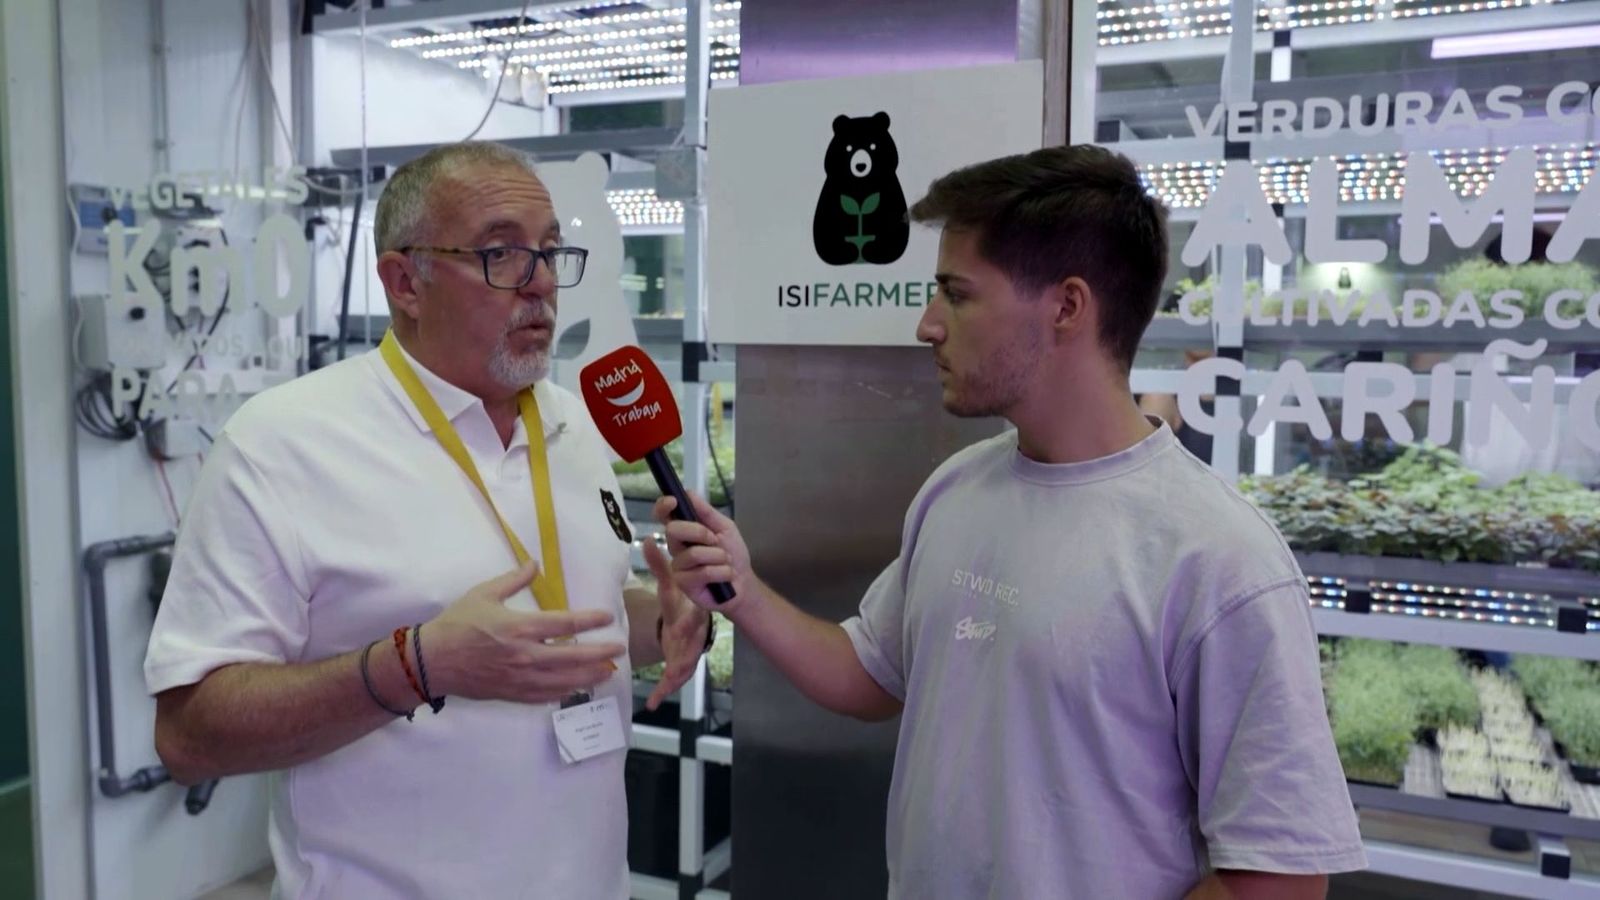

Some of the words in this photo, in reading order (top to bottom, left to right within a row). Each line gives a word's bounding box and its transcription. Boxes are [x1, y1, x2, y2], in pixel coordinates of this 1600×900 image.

[1185, 85, 1524, 143] VERDURAS
[110, 166, 309, 211] VEGETALES
[1177, 288, 1524, 329] CULTIVADAS
[594, 359, 643, 393] Madrid
[612, 401, 662, 427] Trabaja
